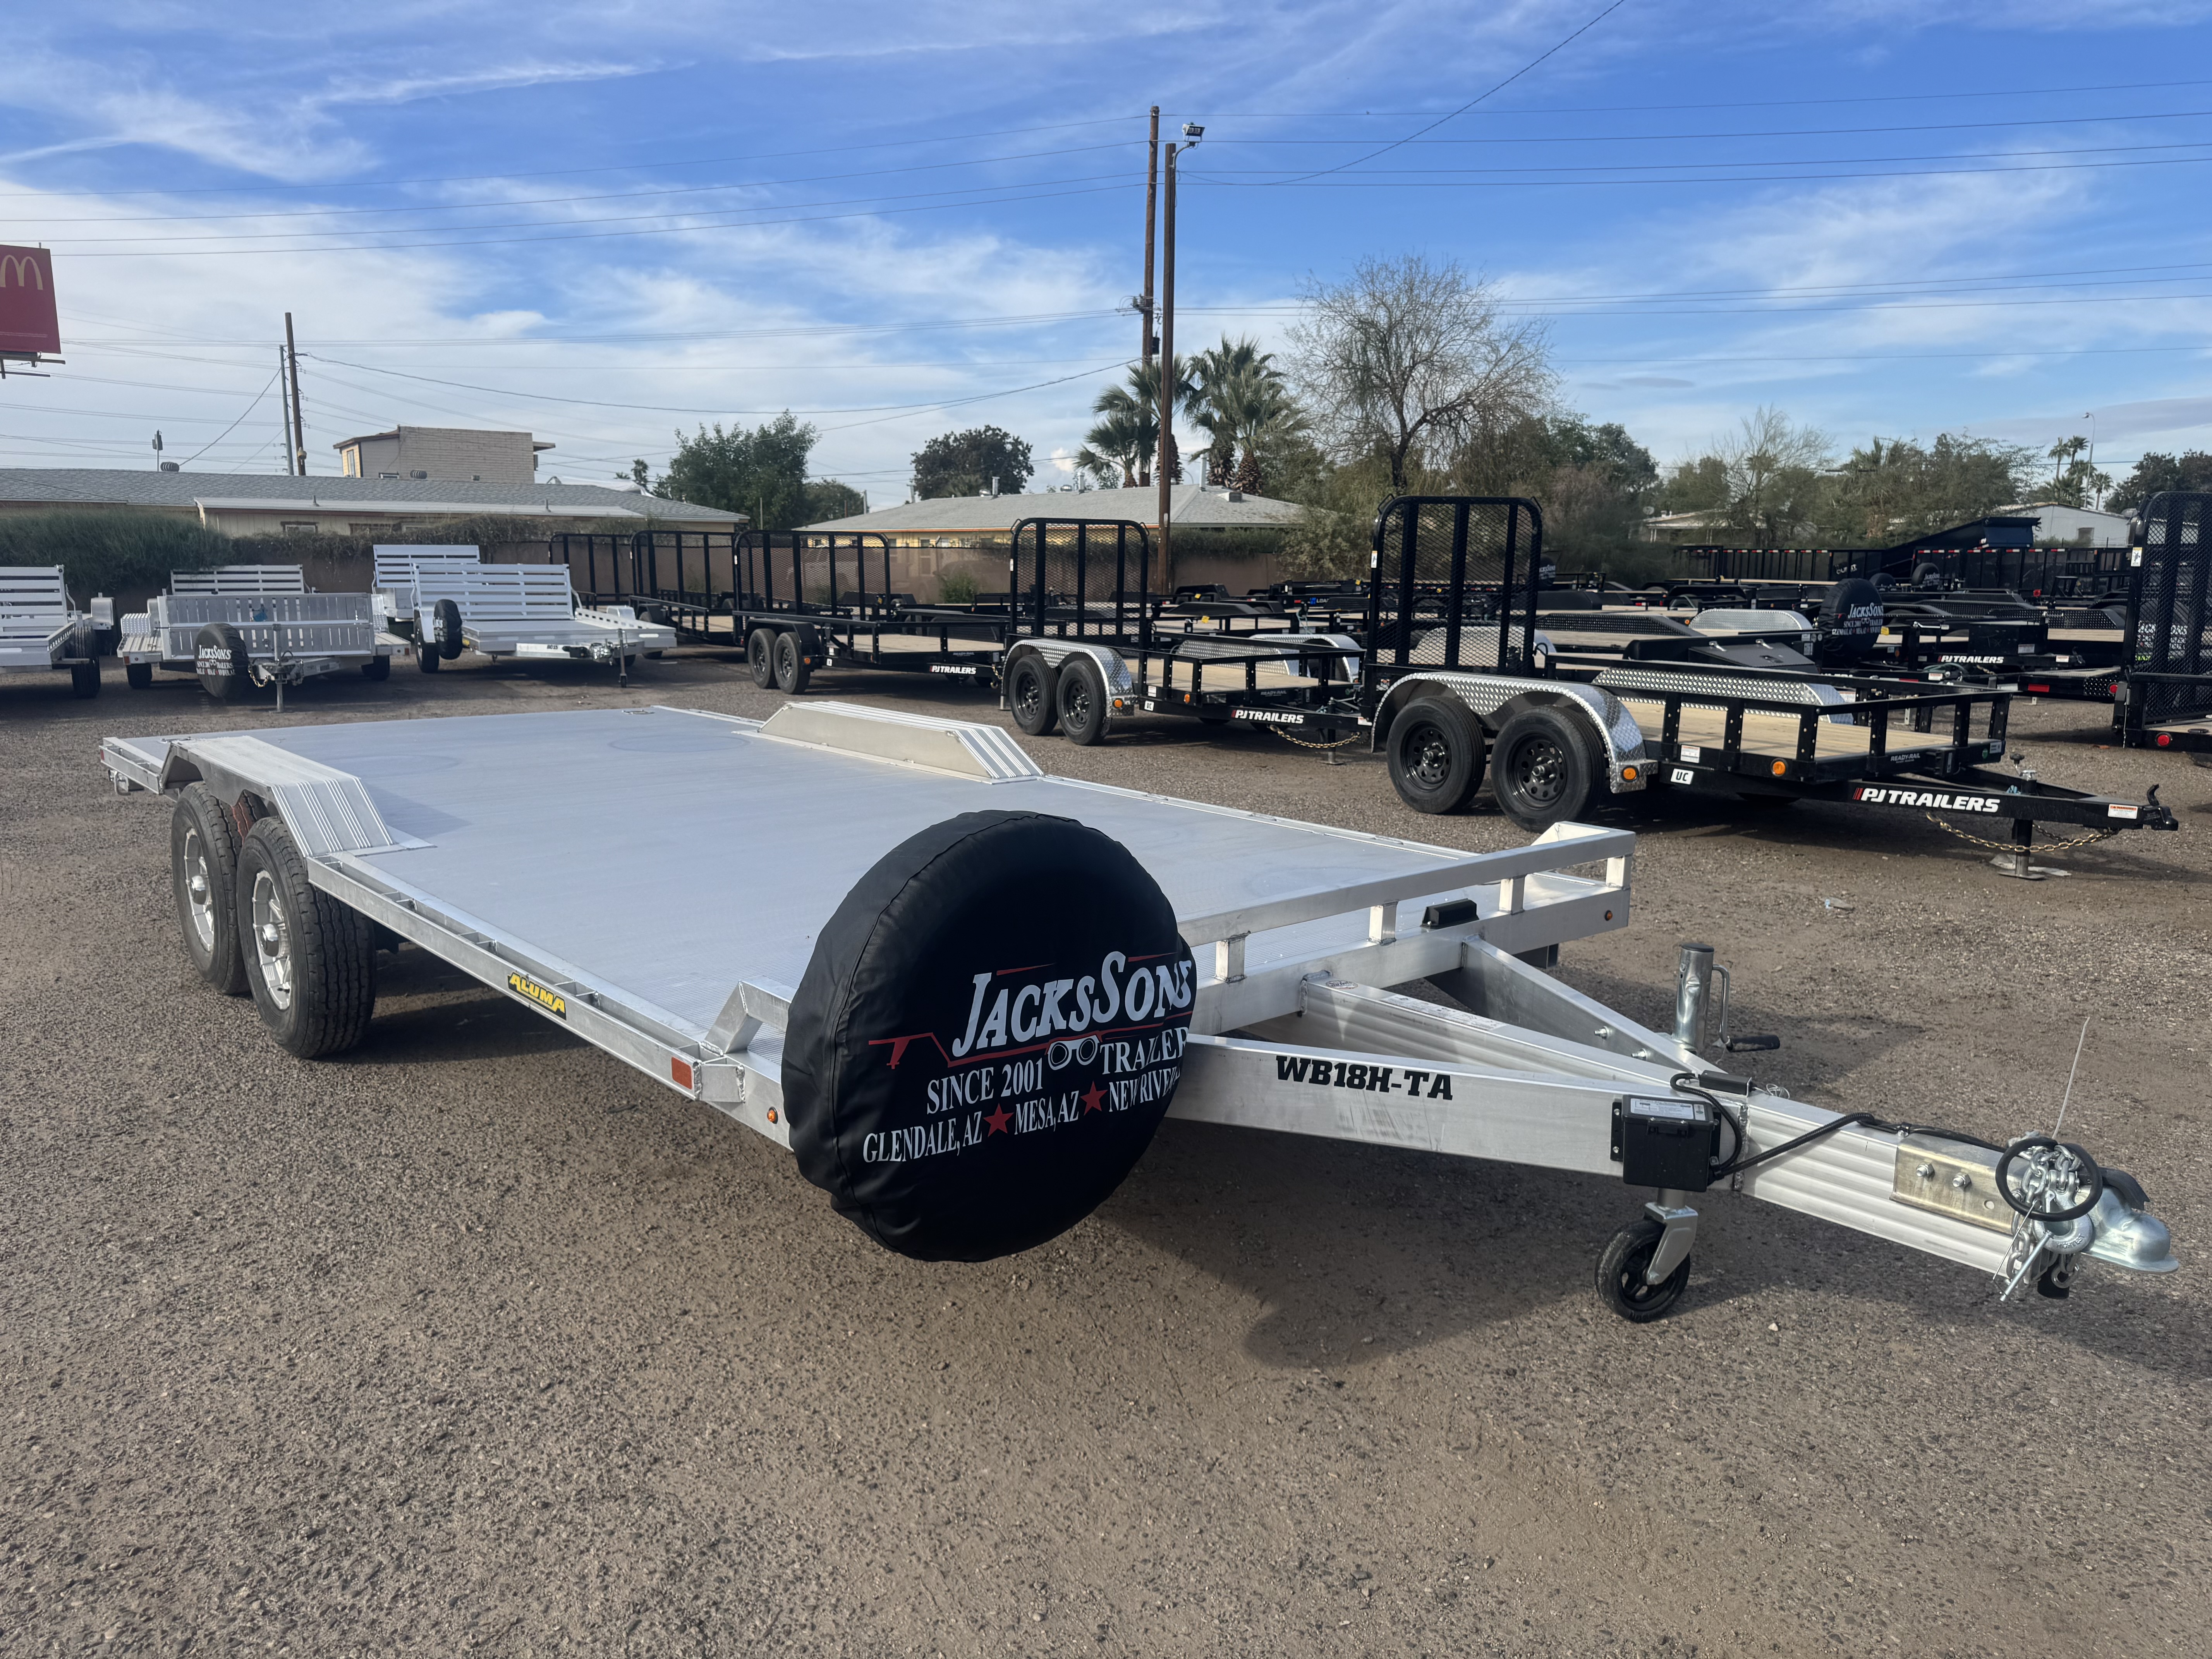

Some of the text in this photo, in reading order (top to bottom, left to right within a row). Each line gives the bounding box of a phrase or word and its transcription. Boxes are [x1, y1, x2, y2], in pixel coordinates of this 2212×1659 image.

[1248, 711, 1304, 724] TRAILERS
[1676, 771, 1689, 782] UC
[1887, 790, 2001, 813] TRAILERS
[508, 972, 566, 1014] ALUMA
[927, 1067, 994, 1115] SINCE
[1001, 1057, 1044, 1097] 2001
[1276, 1055, 1453, 1101] WB18H-TA
